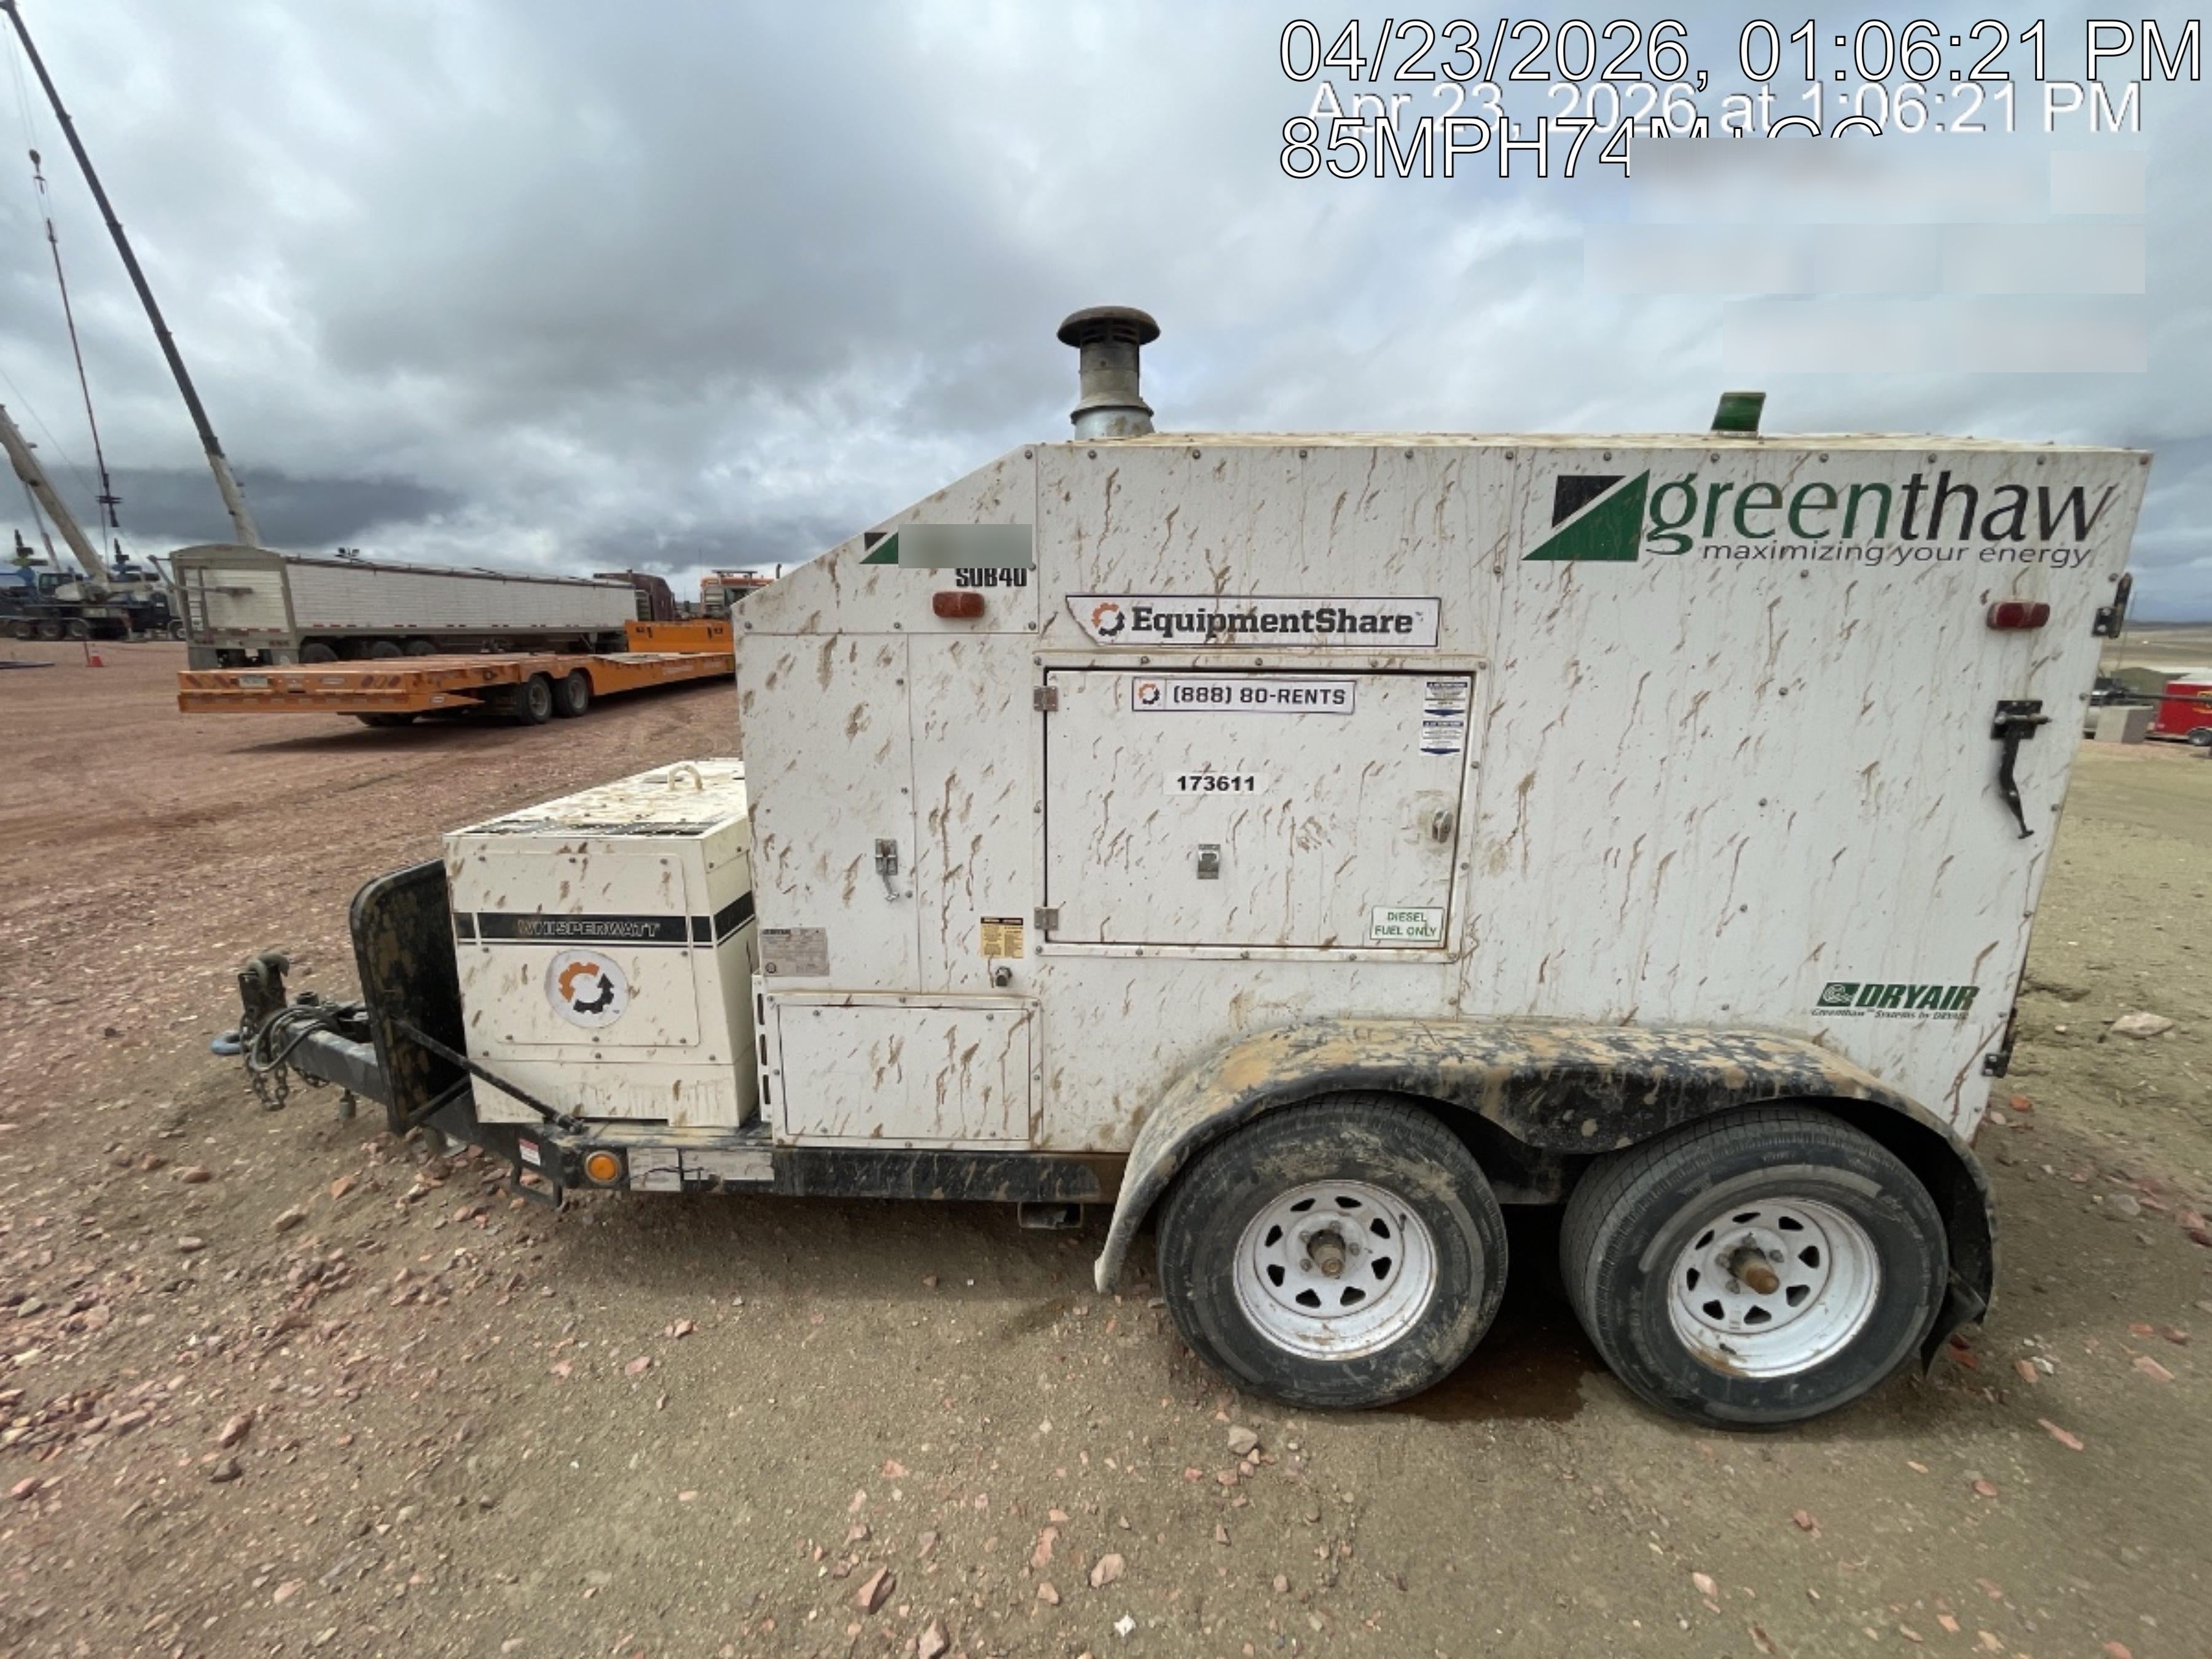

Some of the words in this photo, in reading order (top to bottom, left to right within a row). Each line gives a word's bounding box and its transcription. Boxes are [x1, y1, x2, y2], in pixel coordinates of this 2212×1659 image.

[1646, 469, 2115, 555] greenthaw
[1703, 539, 1885, 567] maximizing
[1891, 543, 1969, 566] your
[1979, 545, 2092, 568] energy
[1131, 606, 1413, 639] EquipmentShare
[1174, 685, 1232, 704] (888)
[1239, 687, 1346, 705] 80-RENTS
[1177, 775, 1254, 791] 173611
[1387, 912, 1427, 922] DIESEL
[517, 919, 661, 937] WHISPERWATT
[1375, 925, 1403, 935] FUEL
[1406, 926, 1437, 936] ONLY
[1854, 983, 1980, 1010] DRYAIR
